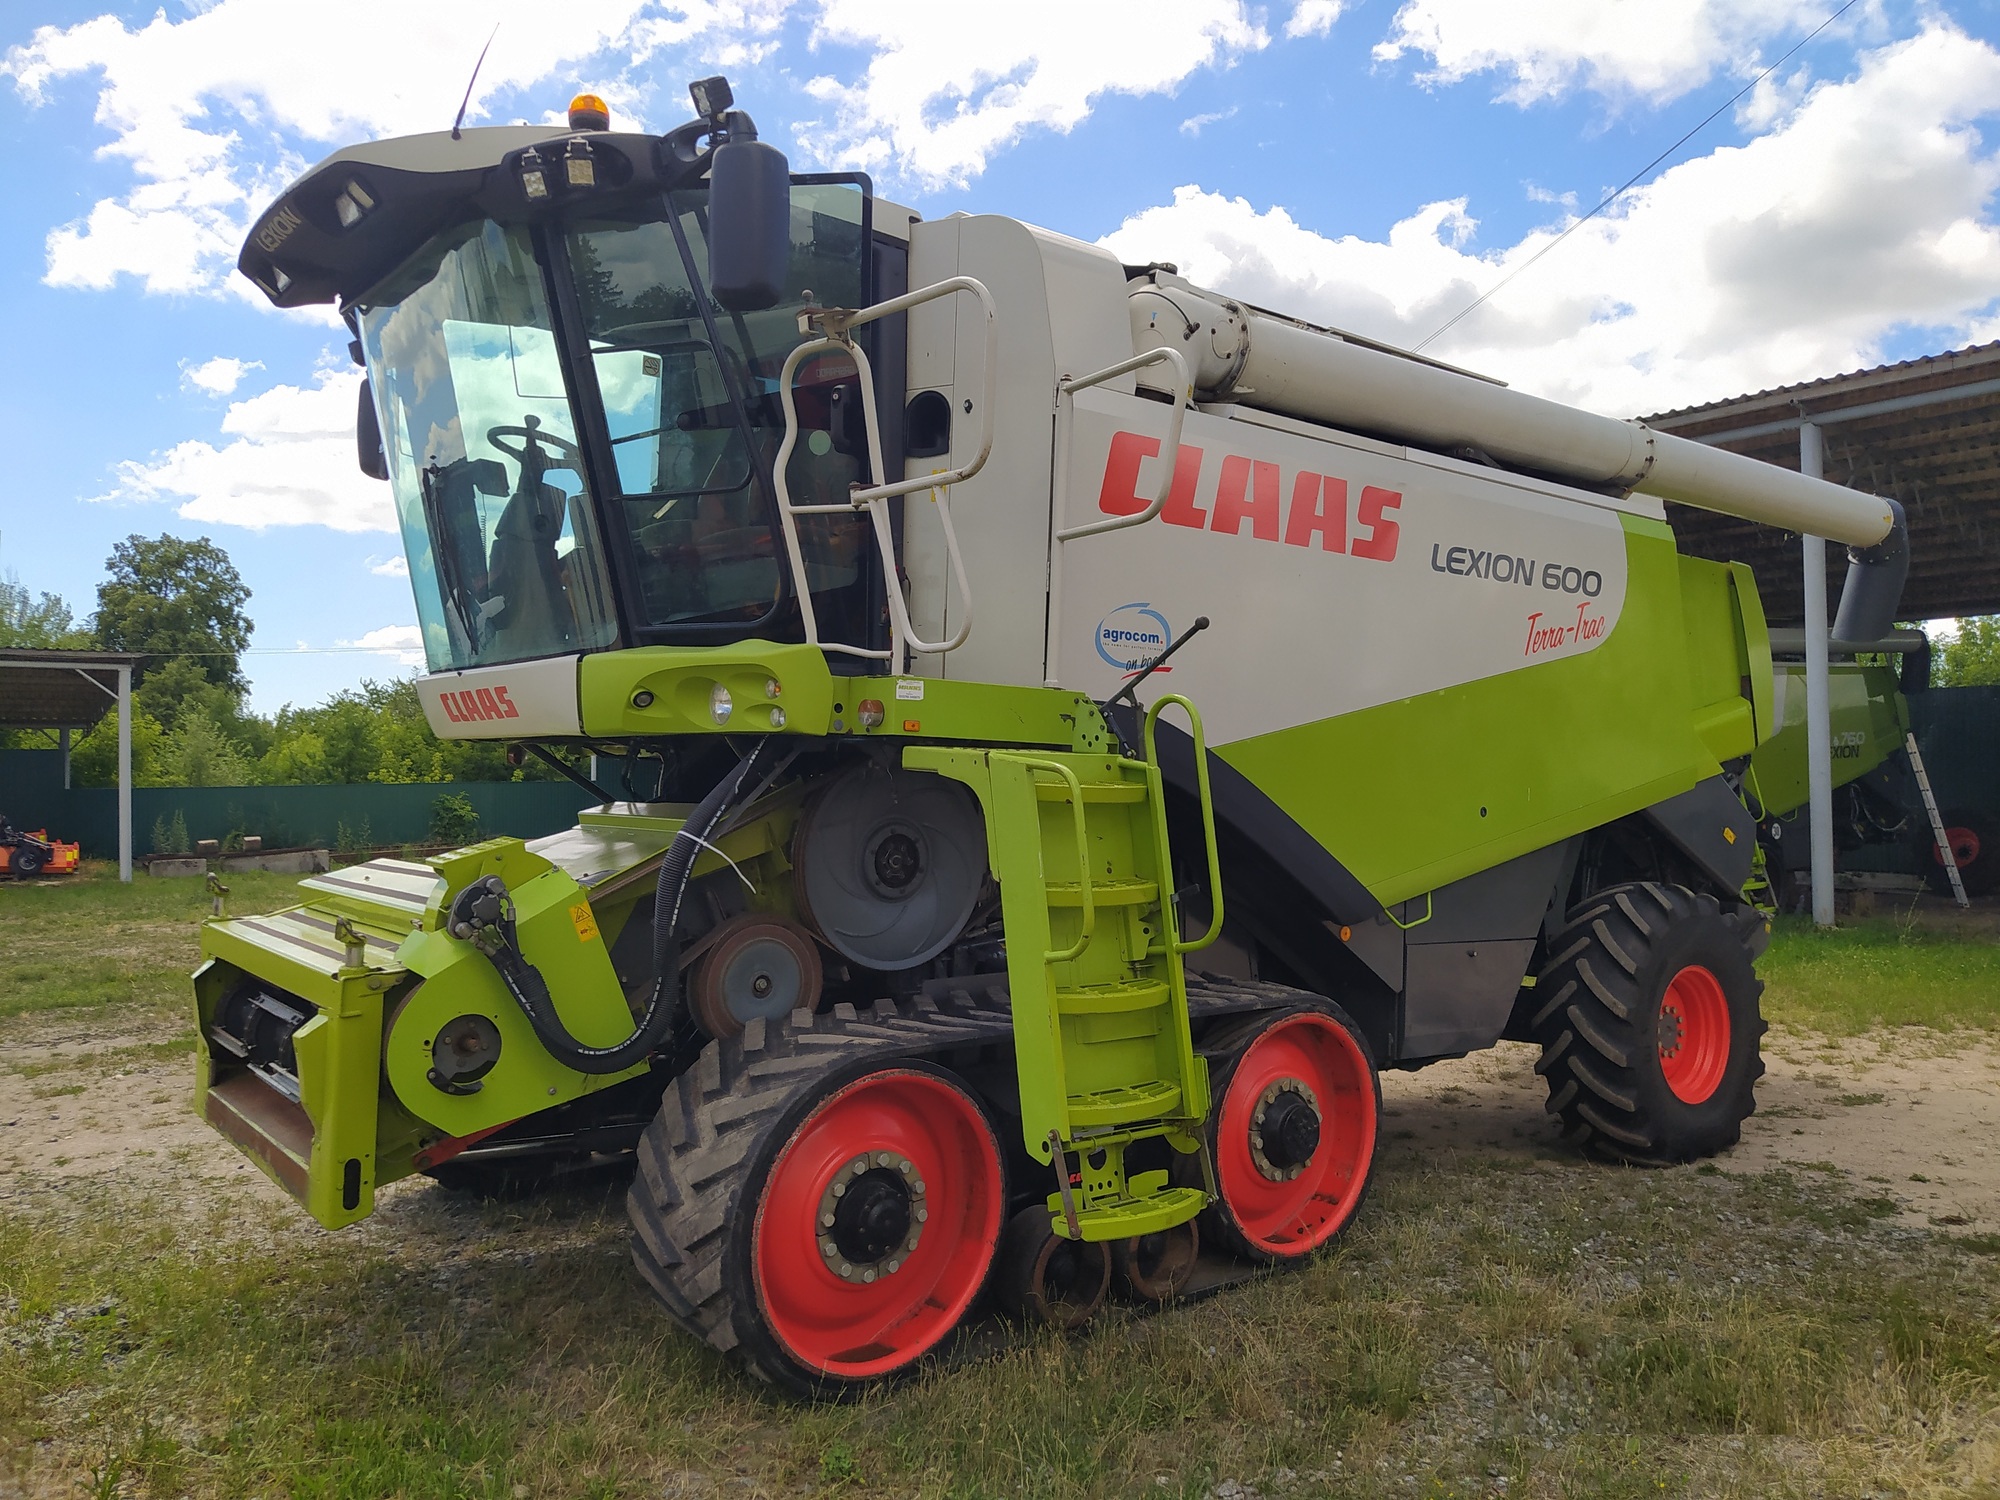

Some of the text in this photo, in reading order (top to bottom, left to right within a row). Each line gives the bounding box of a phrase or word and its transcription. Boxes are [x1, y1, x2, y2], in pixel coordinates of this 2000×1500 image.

[255, 206, 302, 252] LEXION
[1098, 430, 1403, 562] CLAAS
[1431, 543, 1602, 597] LEXION 600
[1524, 601, 1606, 656] Terra-Trac
[1125, 658, 1138, 671] on
[440, 686, 519, 722] CLAAS
[1772, 826, 1780, 838] 30
